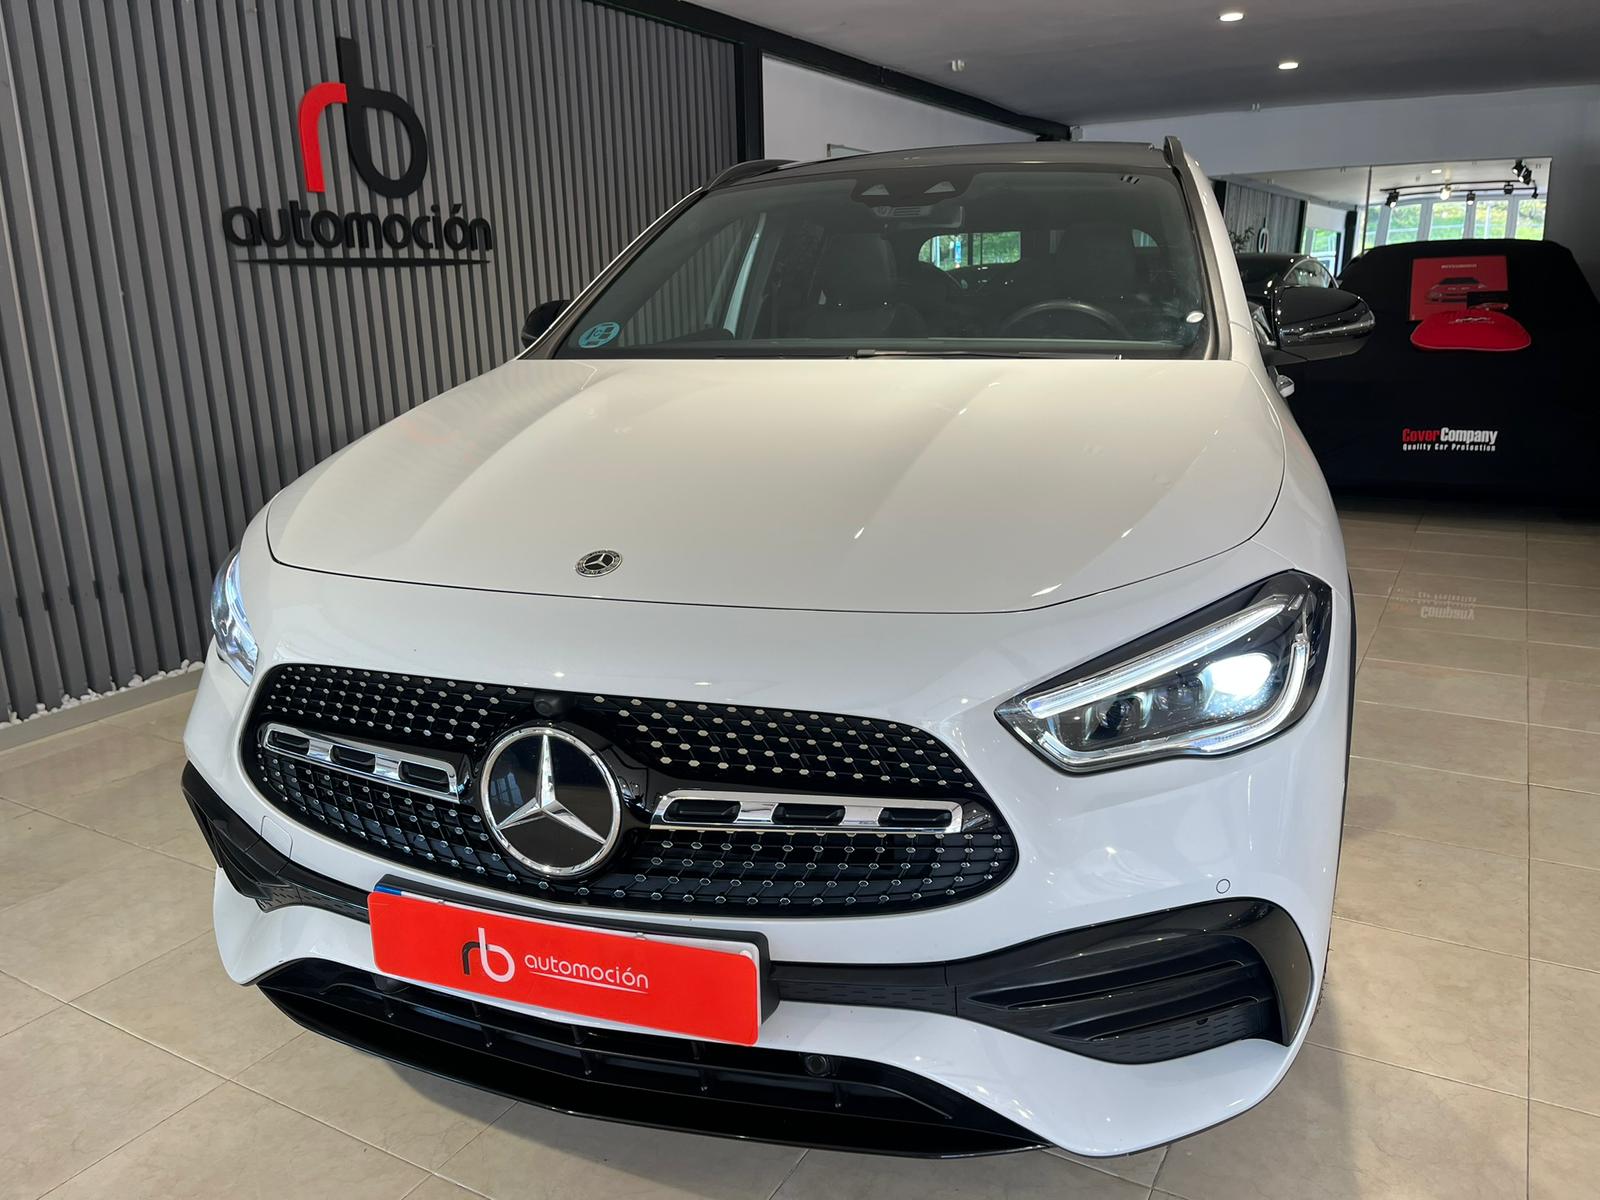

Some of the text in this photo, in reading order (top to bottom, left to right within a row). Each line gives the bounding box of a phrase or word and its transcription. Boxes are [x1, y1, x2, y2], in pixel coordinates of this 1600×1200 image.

[222, 200, 492, 251] automoción
[1402, 443, 1496, 452] Quality Car Protection
[462, 927, 649, 989] rb automoción
